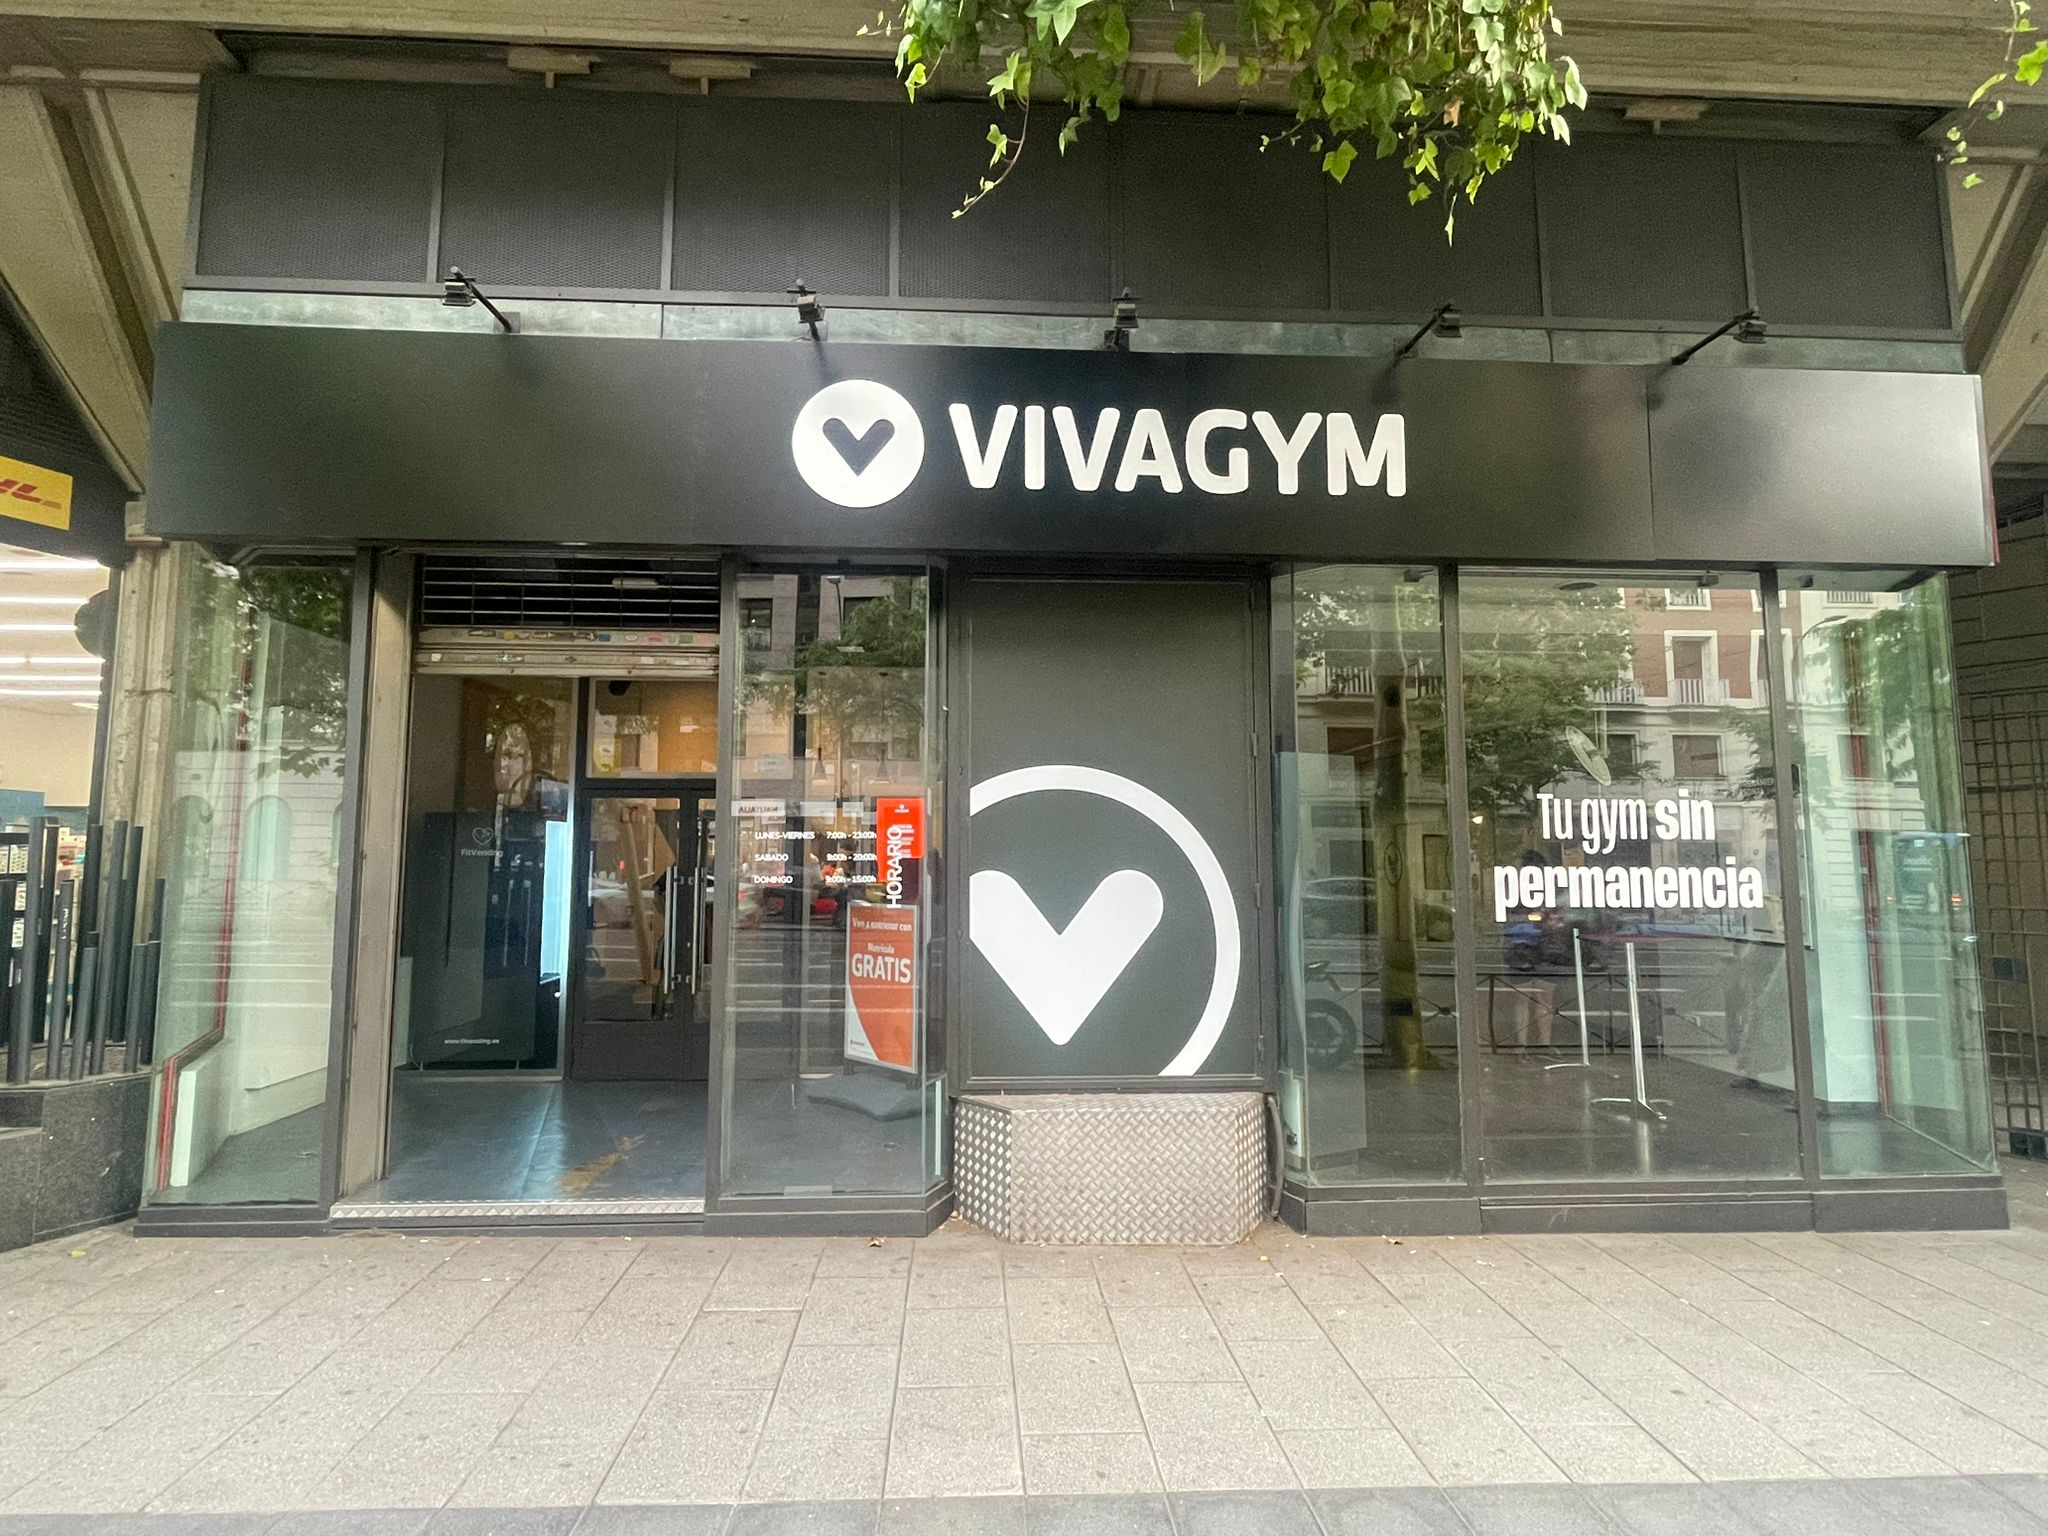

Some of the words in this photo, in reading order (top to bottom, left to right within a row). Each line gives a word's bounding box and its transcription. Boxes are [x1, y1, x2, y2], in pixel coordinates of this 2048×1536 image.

[949, 403, 1406, 497] VIVAGYM
[755, 831, 815, 840] LUNES-VIERNES
[1537, 793, 1573, 840] Tu
[1581, 797, 1648, 854] gym
[1654, 788, 1715, 840] sin
[754, 875, 793, 884] DOMINGO
[886, 825, 903, 909] HORARIO
[1493, 856, 1764, 923] permanencia
[852, 952, 912, 984] GRATIS
